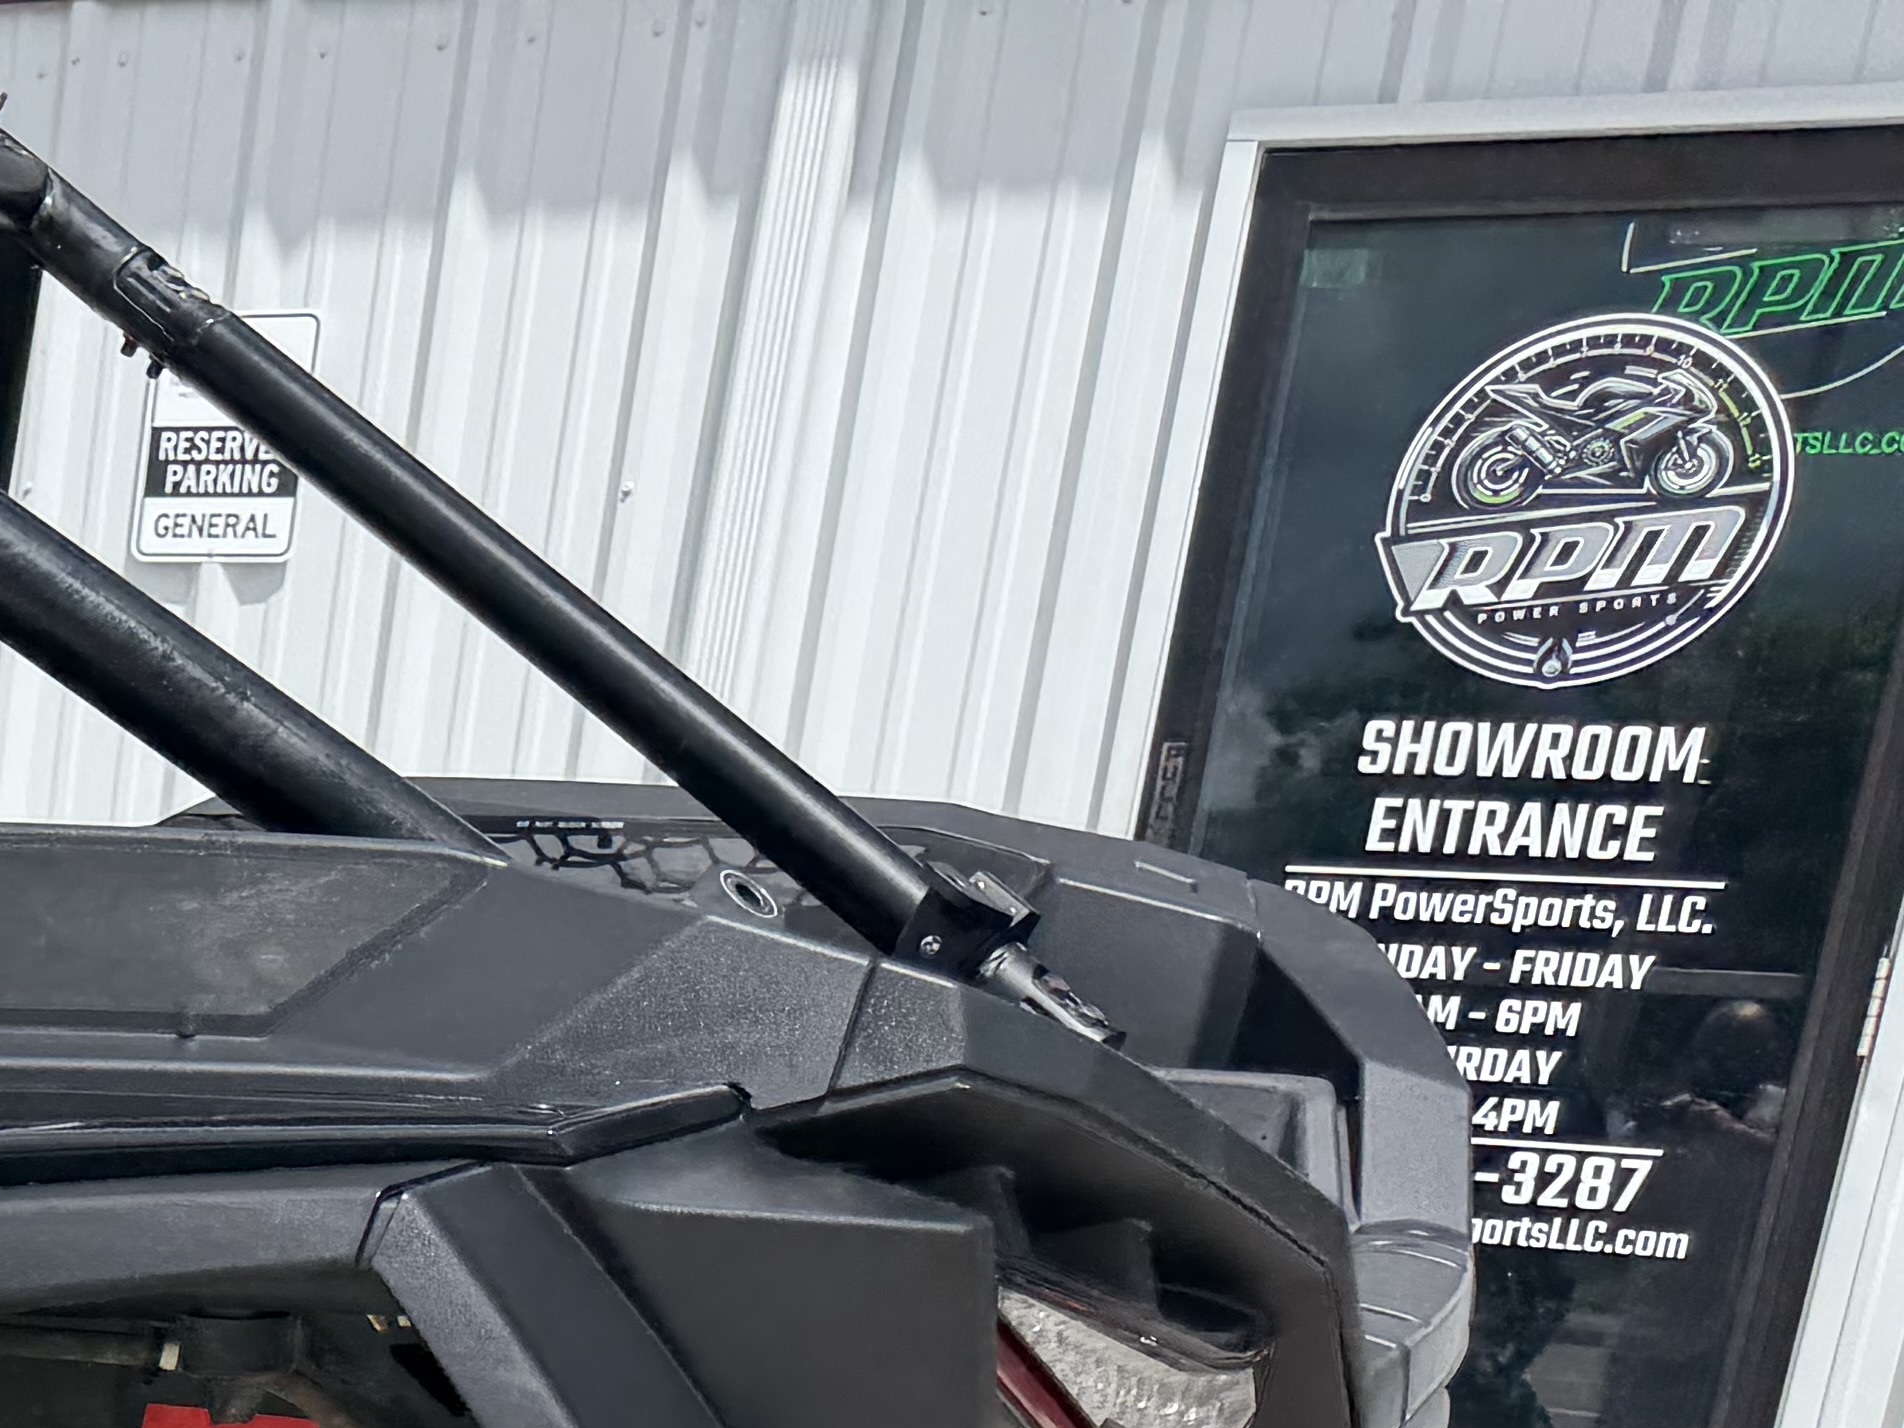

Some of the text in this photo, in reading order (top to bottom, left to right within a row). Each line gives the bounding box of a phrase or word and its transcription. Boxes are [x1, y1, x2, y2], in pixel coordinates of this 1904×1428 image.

[1793, 431, 1904, 455] TSLLC.C
[164, 464, 279, 494] PARKING
[154, 513, 277, 539] GENERAL
[1411, 506, 1745, 612] RPM
[1477, 592, 1678, 625] POWER SPORTS
[1357, 719, 1707, 784] SHOWROOM
[1365, 797, 1665, 862] ENTRANCE
[1369, 882, 1625, 938] PowerSports,
[1636, 893, 1715, 934] LLC.
[1509, 949, 1657, 990] FRIDAY
[1495, 998, 1582, 1037] 6PM
[1472, 1096, 1560, 1135] 4PM
